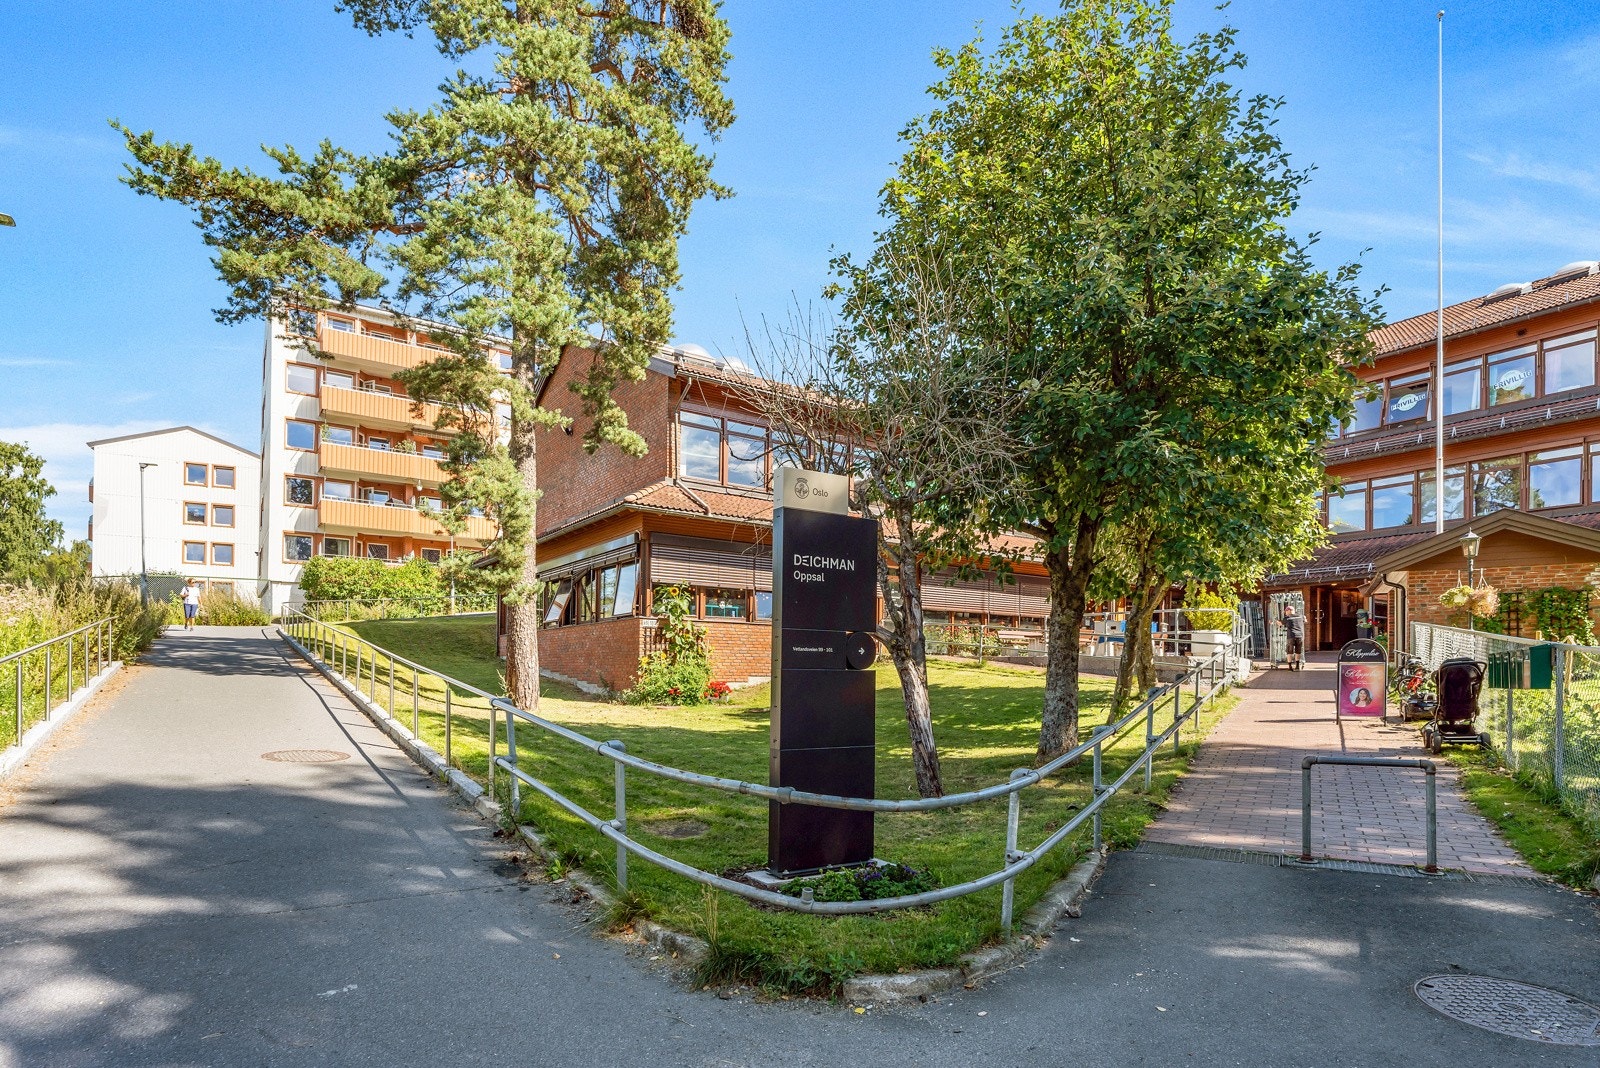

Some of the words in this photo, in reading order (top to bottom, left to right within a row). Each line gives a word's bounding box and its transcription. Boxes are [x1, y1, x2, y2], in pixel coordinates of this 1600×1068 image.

[1493, 370, 1532, 390] FRIVILLIG
[812, 487, 829, 498] Oslo
[793, 554, 855, 571] DEICHMAN
[793, 570, 825, 583] Oppsal
